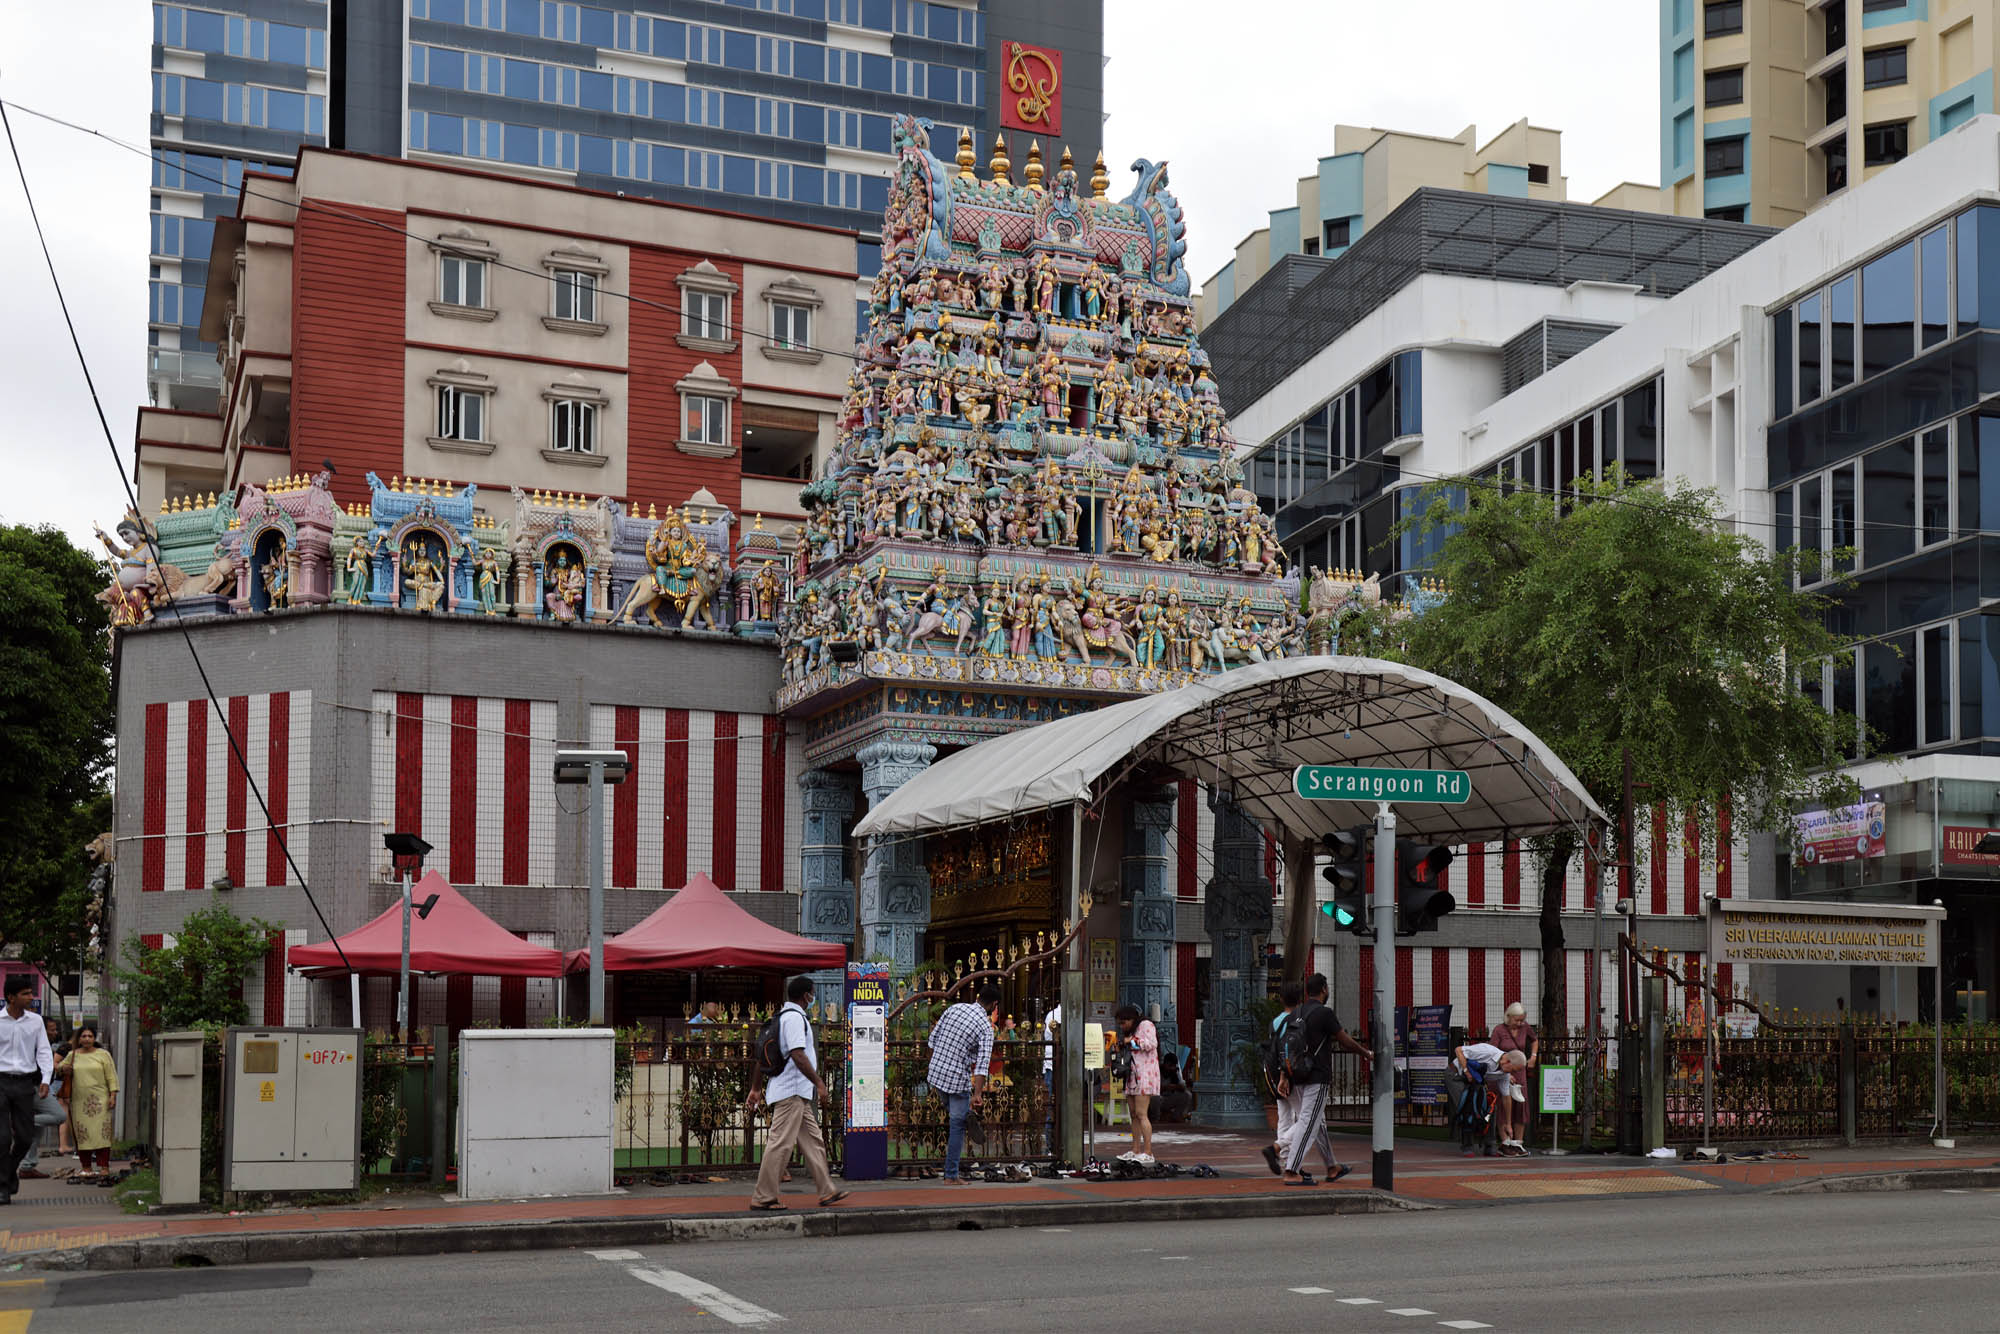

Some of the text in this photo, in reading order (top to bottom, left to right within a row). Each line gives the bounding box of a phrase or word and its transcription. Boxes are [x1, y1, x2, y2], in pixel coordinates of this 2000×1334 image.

[1309, 769, 1460, 797] Serangoon Rd
[1726, 928, 1927, 947] SRI VEERAMAKALIAMMAN TEMPLE
[1726, 949, 1741, 959] 141
[1743, 949, 1806, 960] SERANGOON
[1807, 950, 1837, 962] ROAD,
[1839, 950, 1893, 962] SINGAPORE
[858, 981, 879, 989] LITTLE
[853, 988, 884, 1000] INDIA
